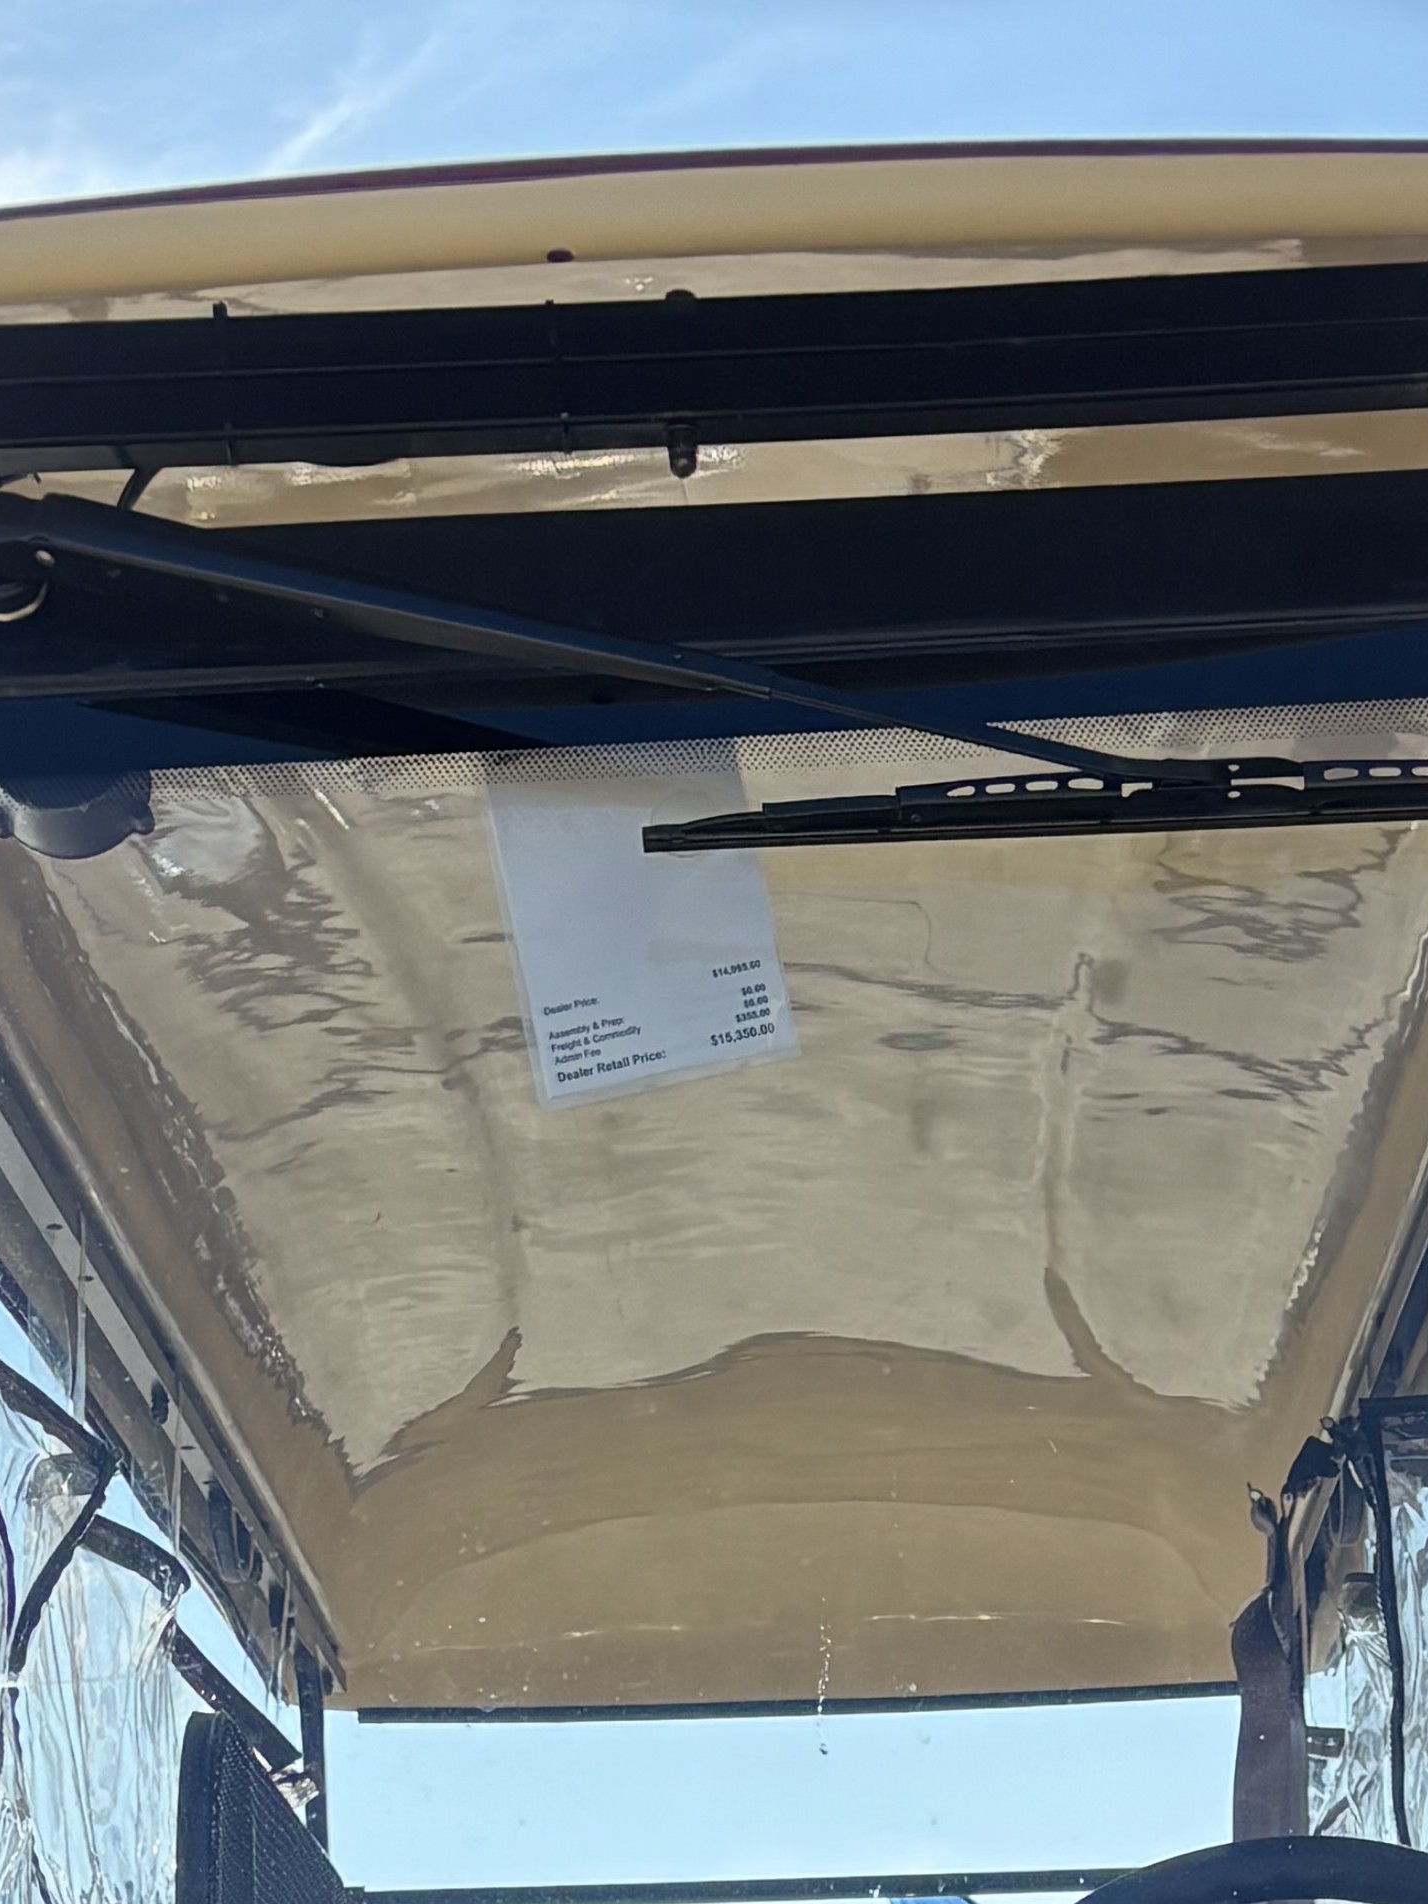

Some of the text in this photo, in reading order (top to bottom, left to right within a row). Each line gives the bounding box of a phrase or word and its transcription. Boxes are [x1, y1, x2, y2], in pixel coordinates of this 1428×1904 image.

[543, 1003, 572, 1016] Dealer
[549, 1025, 590, 1041] Assembly
[592, 1021, 600, 1030] &
[710, 1022, 775, 1046] $15,350.00
[551, 1039, 582, 1053] Freight
[583, 1037, 591, 1045] &
[555, 1048, 601, 1065] Admin Fee
[557, 1048, 667, 1082] Dealer Retail Price:
